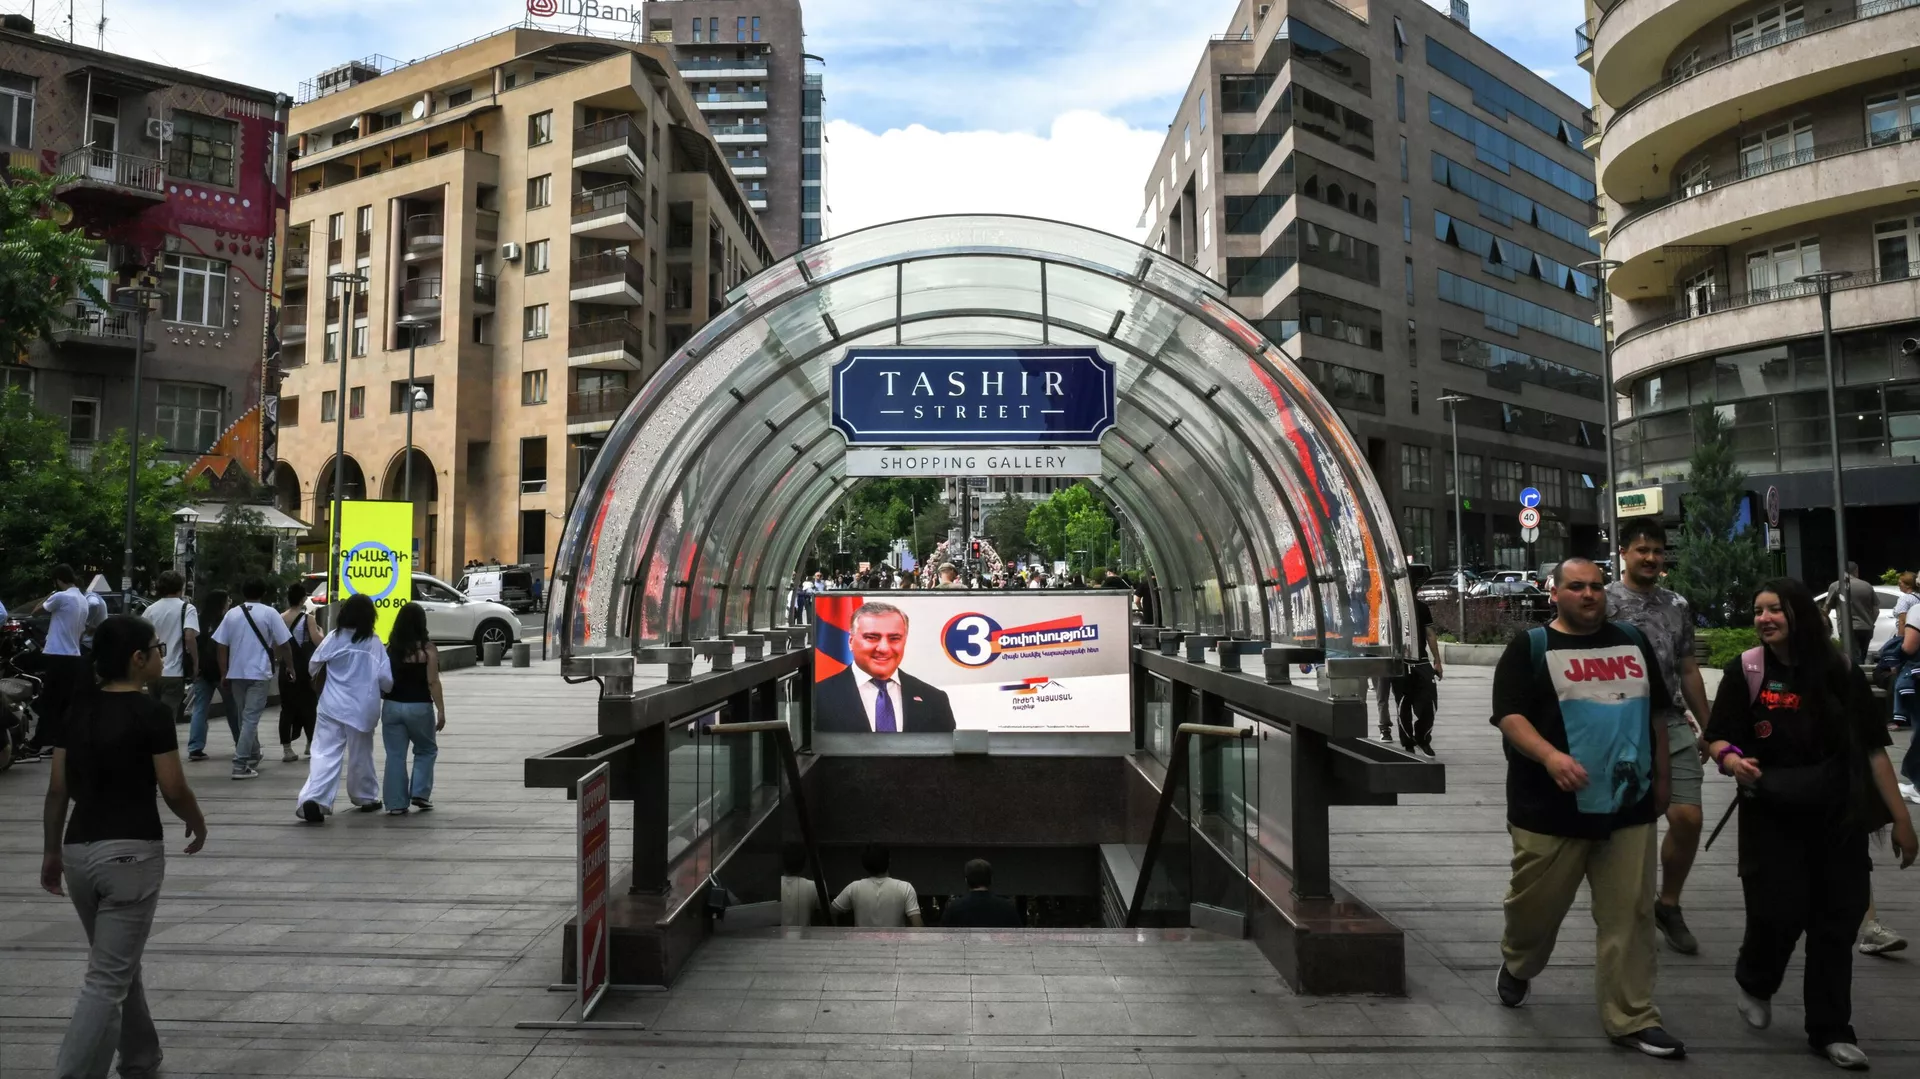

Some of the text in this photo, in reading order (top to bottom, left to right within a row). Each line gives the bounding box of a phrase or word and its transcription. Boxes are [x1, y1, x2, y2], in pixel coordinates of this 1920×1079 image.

[562, 0, 641, 24] IDBank
[879, 371, 1064, 396] TASHIR
[914, 405, 1030, 419] STREET
[881, 456, 1066, 469] SHOPPING GALLERY
[1523, 513, 1535, 522] 40
[955, 616, 992, 666] 3
[1564, 655, 1644, 682] JAWS
